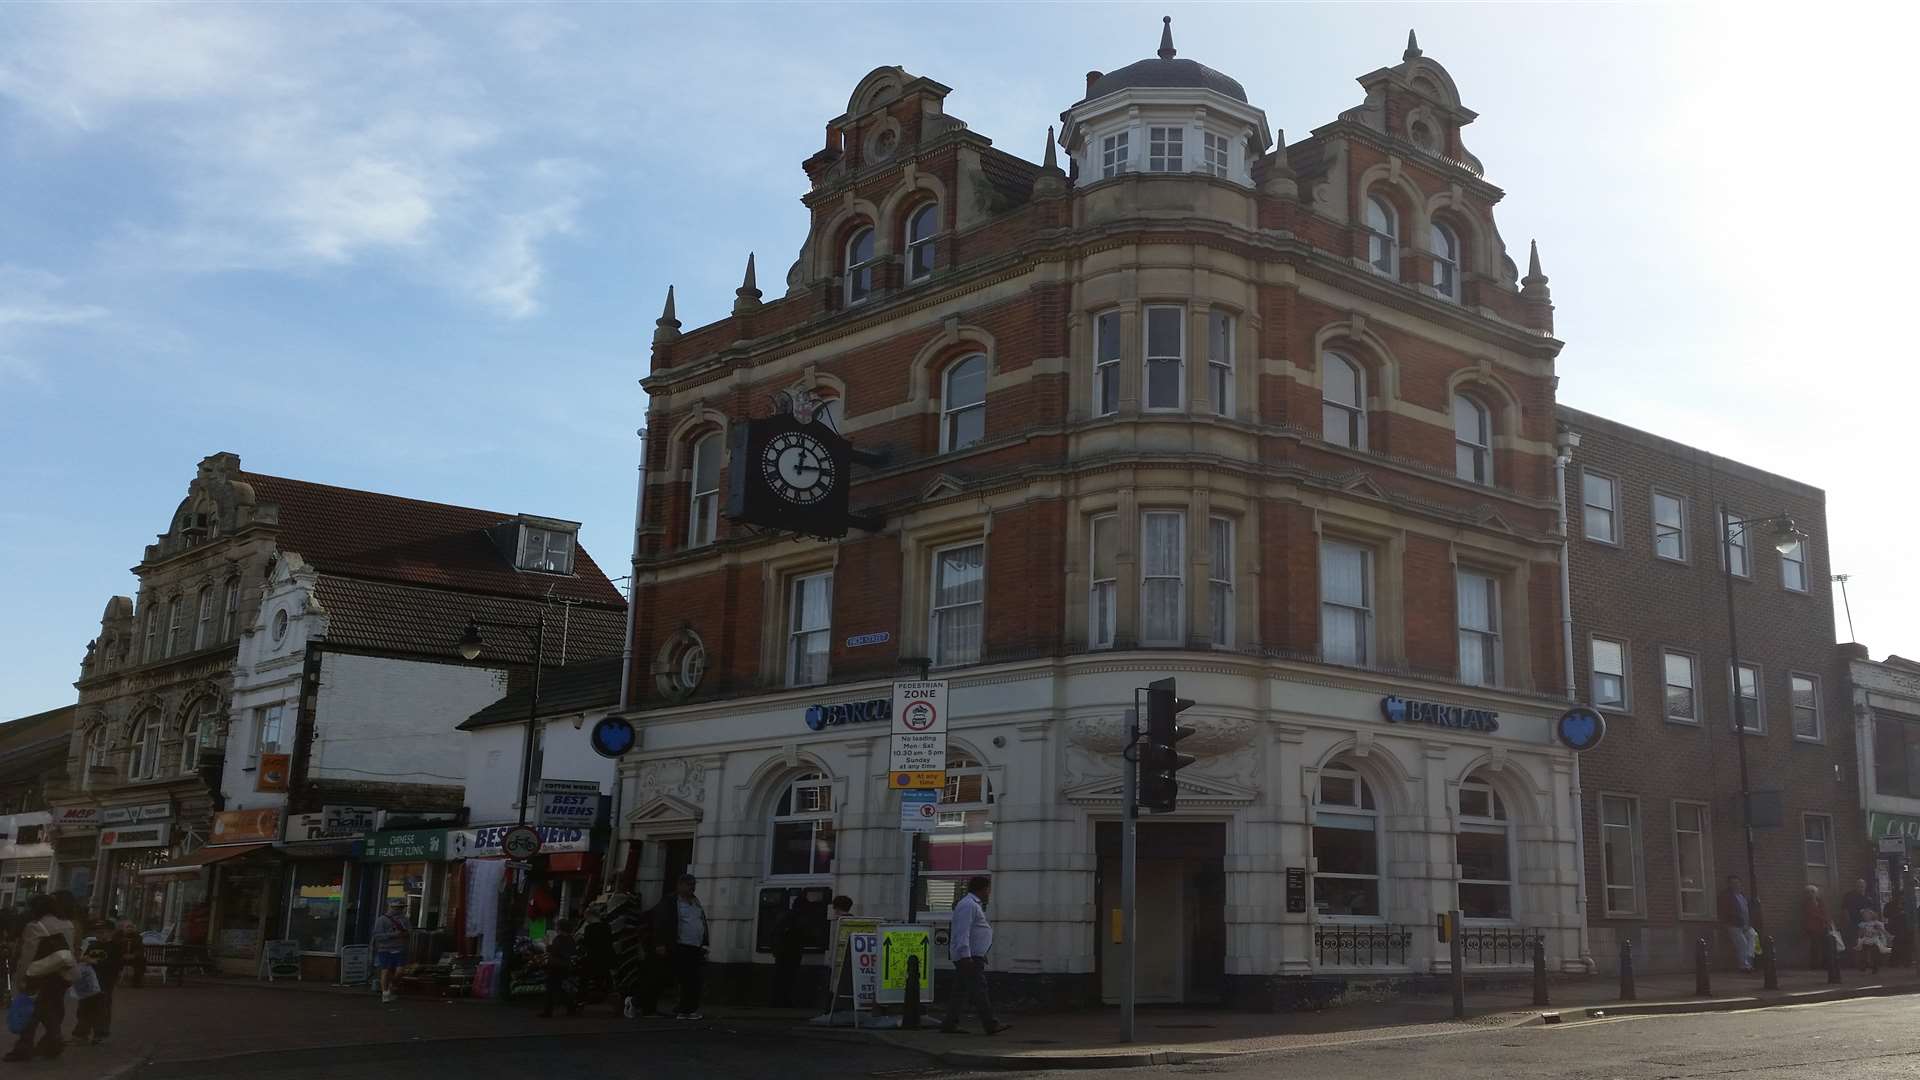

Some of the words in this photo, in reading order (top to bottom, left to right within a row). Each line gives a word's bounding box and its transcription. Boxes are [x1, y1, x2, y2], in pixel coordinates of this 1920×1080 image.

[904, 690, 936, 698] ZONE
[827, 700, 893, 726] BARCLA
[1410, 701, 1499, 732] BARCLAYS
[552, 795, 589, 805] BEST
[543, 805, 595, 816] LINENS
[328, 814, 373, 827] nails
[390, 834, 416, 846] CHINESE
[475, 827, 513, 849] BES
[378, 846, 403, 857] HEALTH
[404, 845, 424, 857] CLINIC
[854, 936, 877, 953] OP
